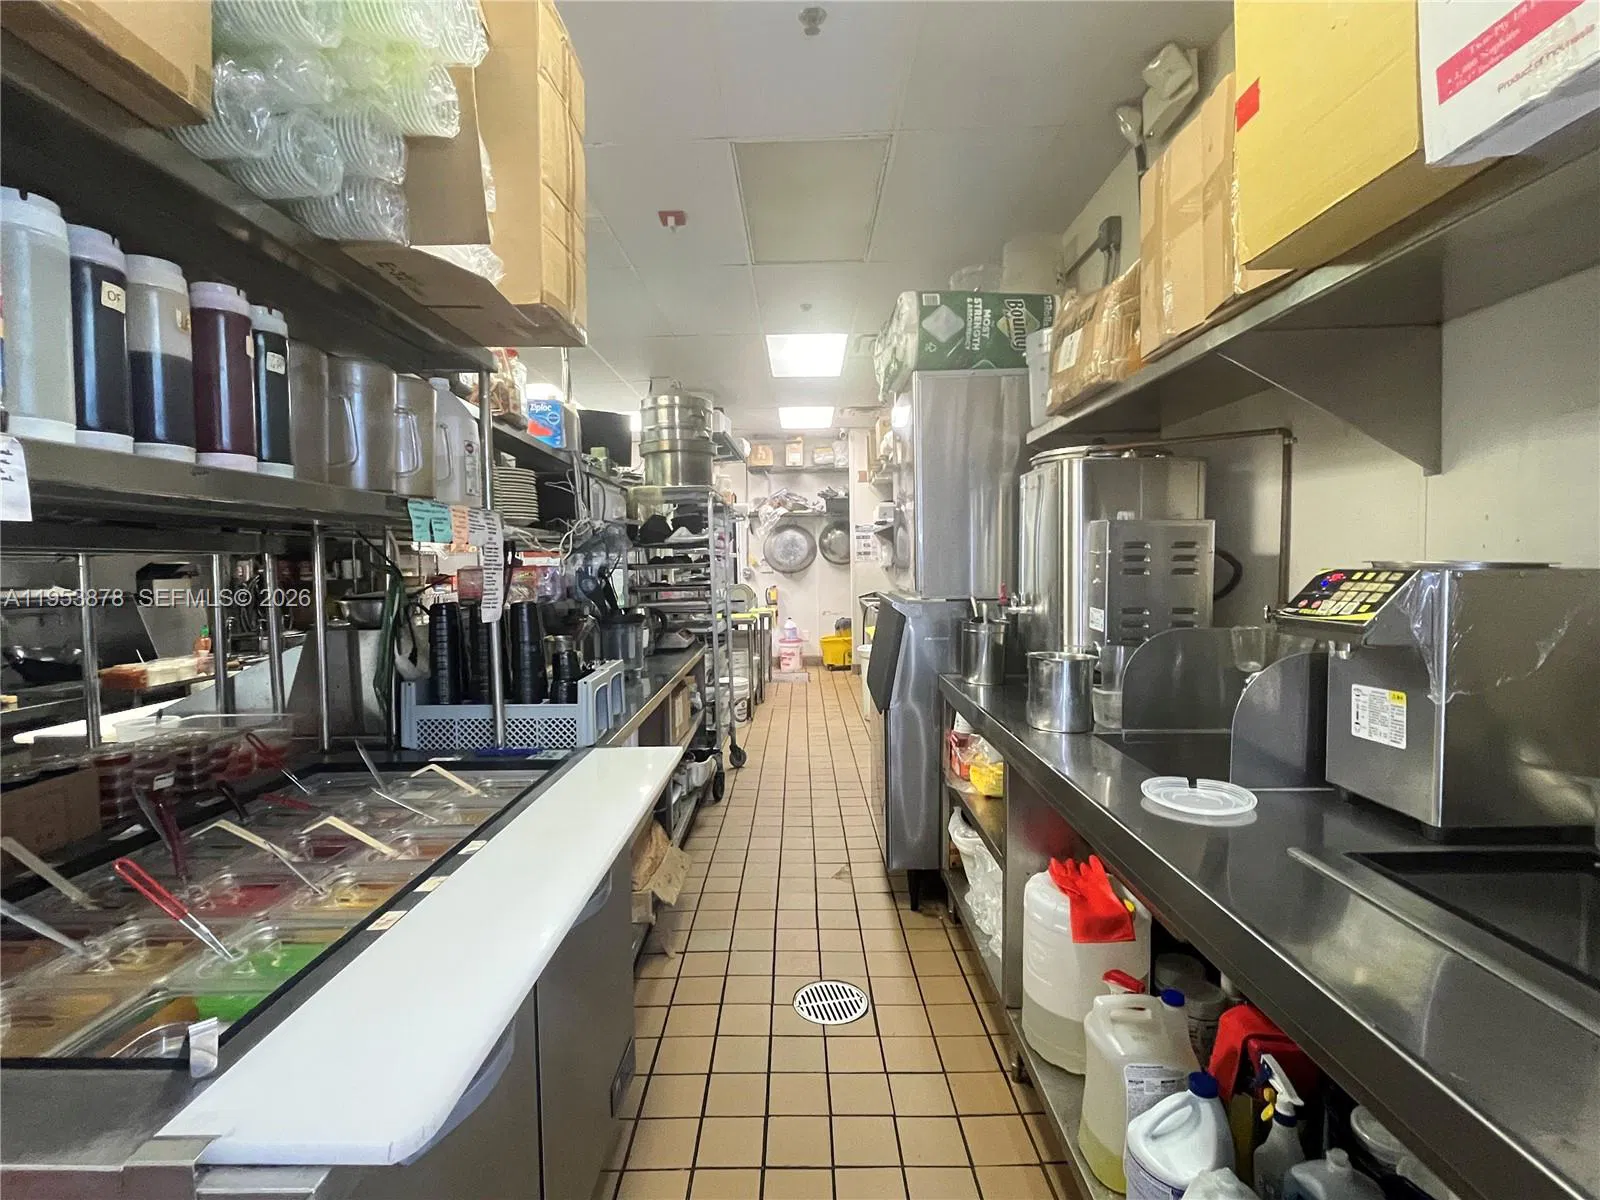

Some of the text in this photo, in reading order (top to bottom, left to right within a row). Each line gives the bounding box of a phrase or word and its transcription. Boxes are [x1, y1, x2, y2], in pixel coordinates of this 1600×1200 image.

[972, 297, 982, 350] STRENGTH
[981, 309, 991, 339] MOST
[1004, 298, 1027, 351] Bounty
[530, 403, 553, 413] Ziploc
